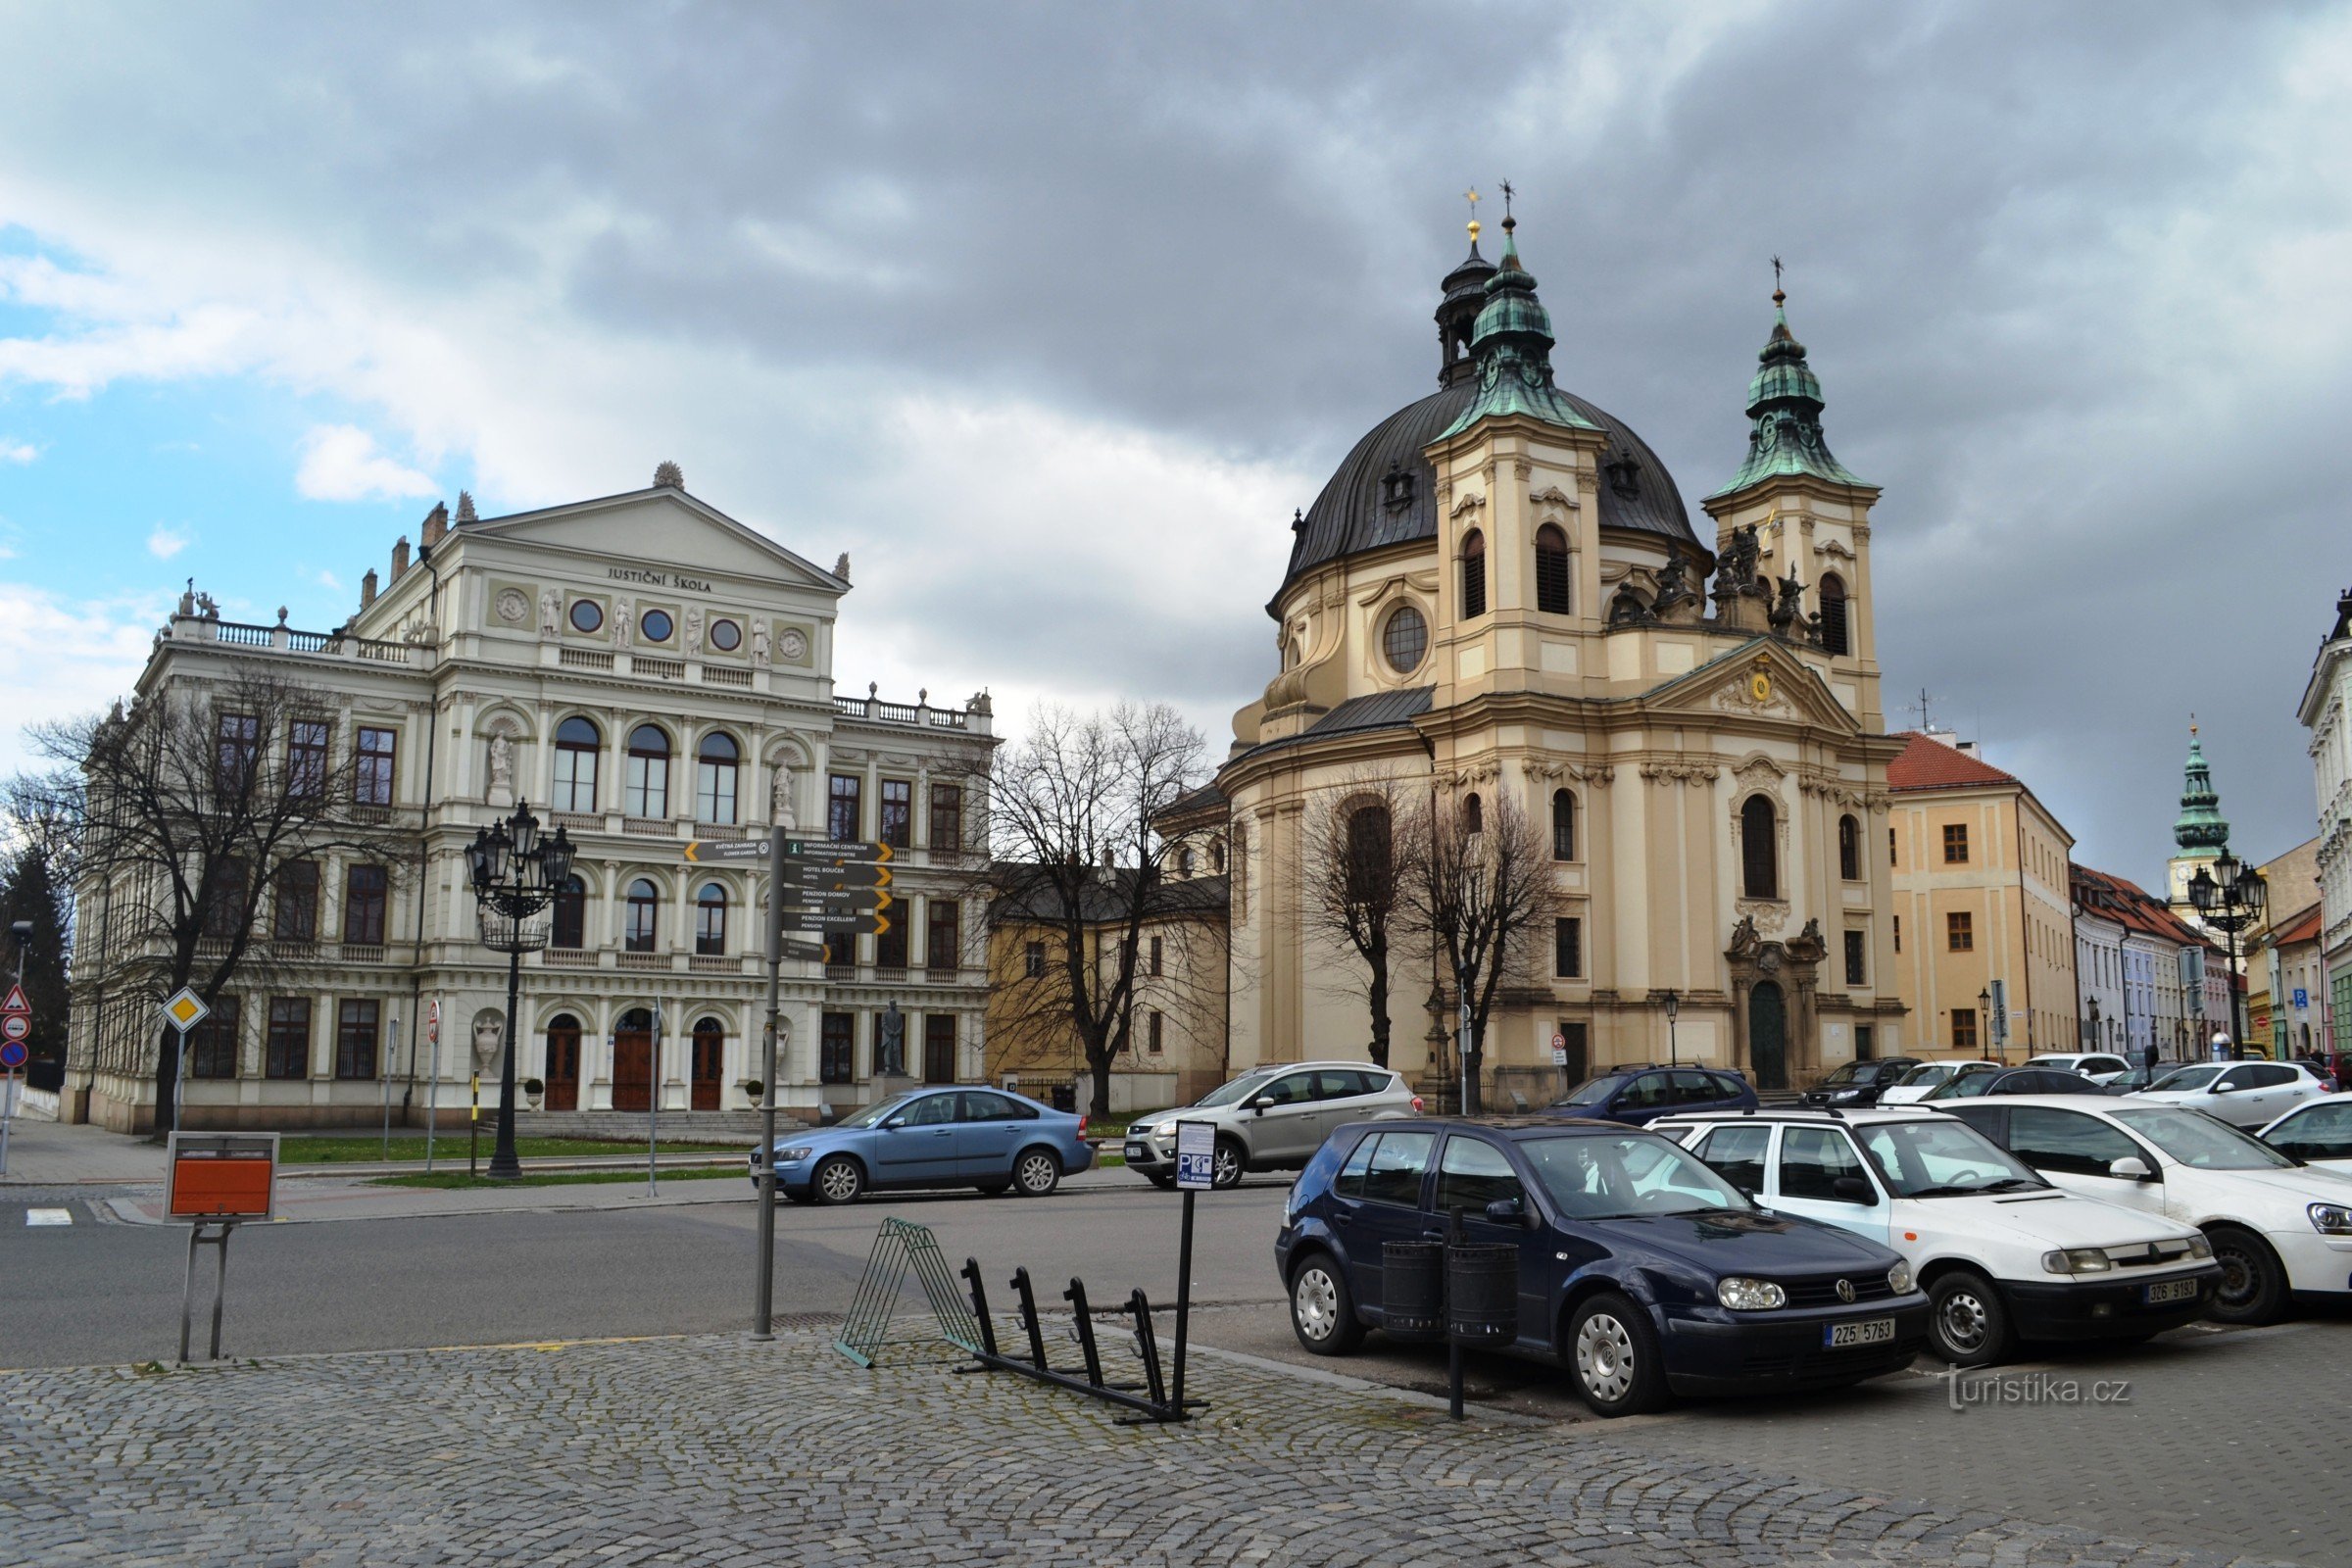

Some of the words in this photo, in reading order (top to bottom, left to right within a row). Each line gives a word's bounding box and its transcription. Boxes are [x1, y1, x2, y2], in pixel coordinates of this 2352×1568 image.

[608, 567, 666, 586] JUSTIČNÍ
[673, 575, 711, 593] ŠKOLA
[2296, 991, 2304, 1002] P
[1179, 1154, 1192, 1172] P
[2150, 1284, 2168, 1301] 3Z6
[1835, 1325, 1857, 1345] 2Z5
[1863, 1321, 1891, 1341] 5763
